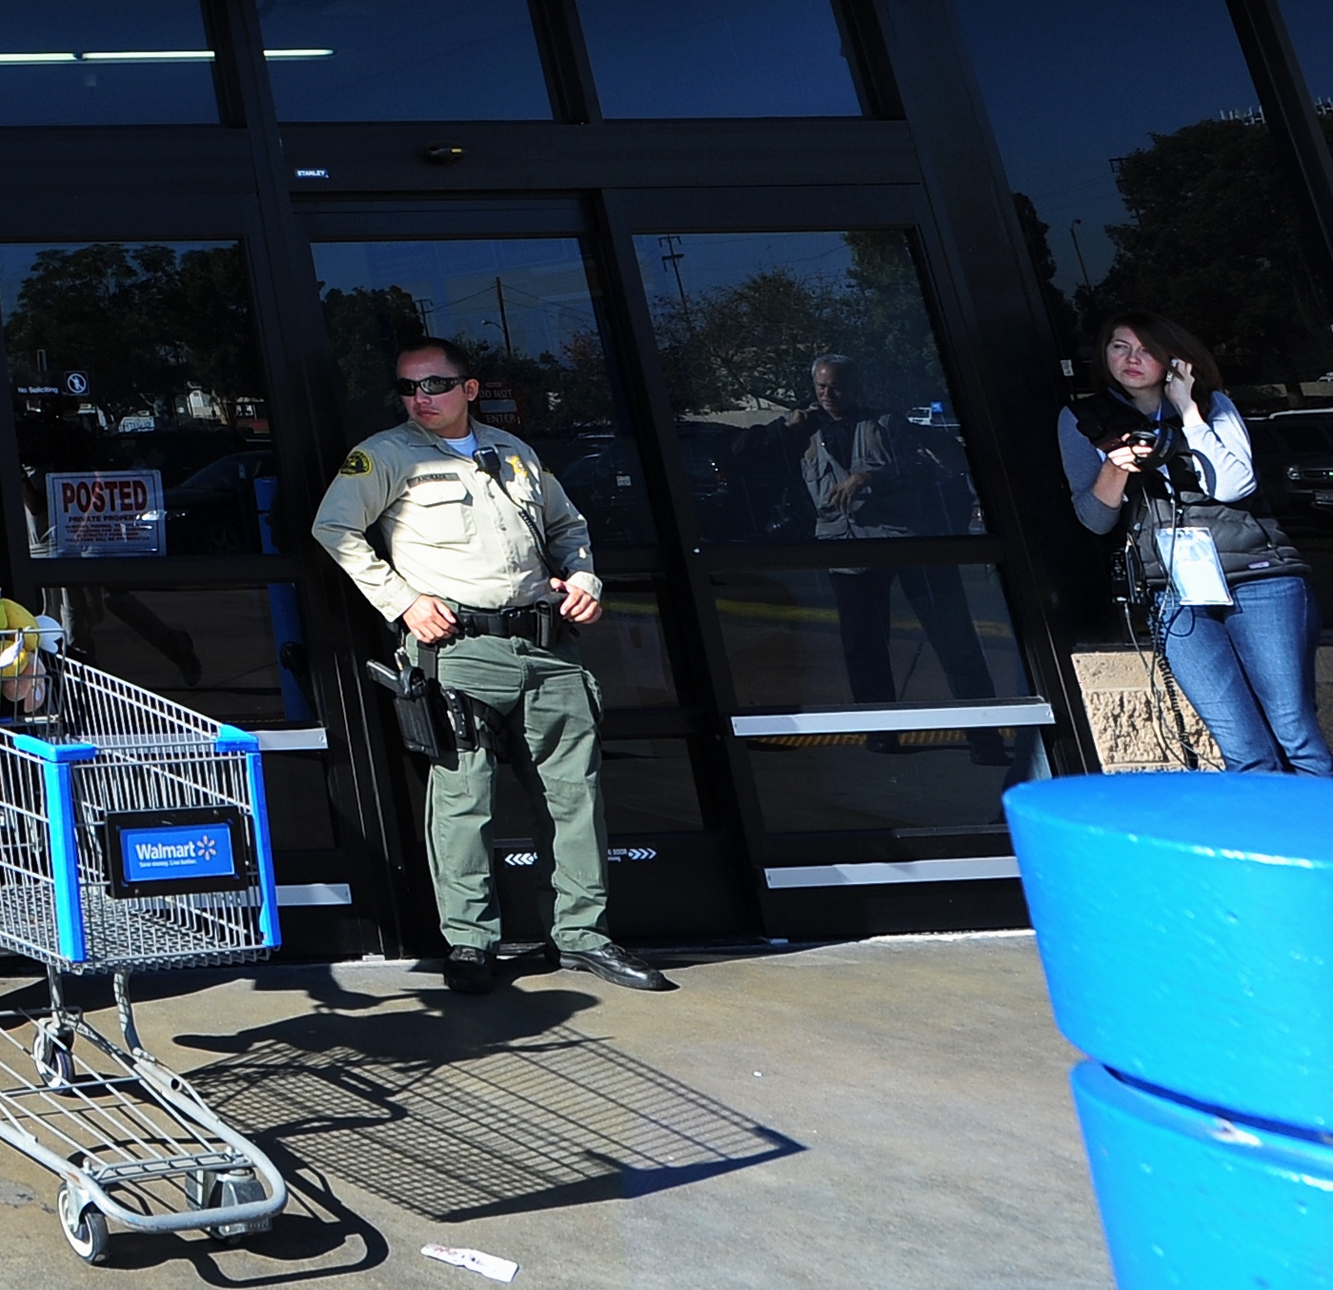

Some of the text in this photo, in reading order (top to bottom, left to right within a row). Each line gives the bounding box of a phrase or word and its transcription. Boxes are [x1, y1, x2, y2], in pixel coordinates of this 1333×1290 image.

[493, 388, 513, 399] NOT
[485, 413, 517, 424] ENTER
[62, 480, 148, 513] POSTED
[103, 514, 141, 522] PROPERT
[135, 840, 197, 861] Walmart
